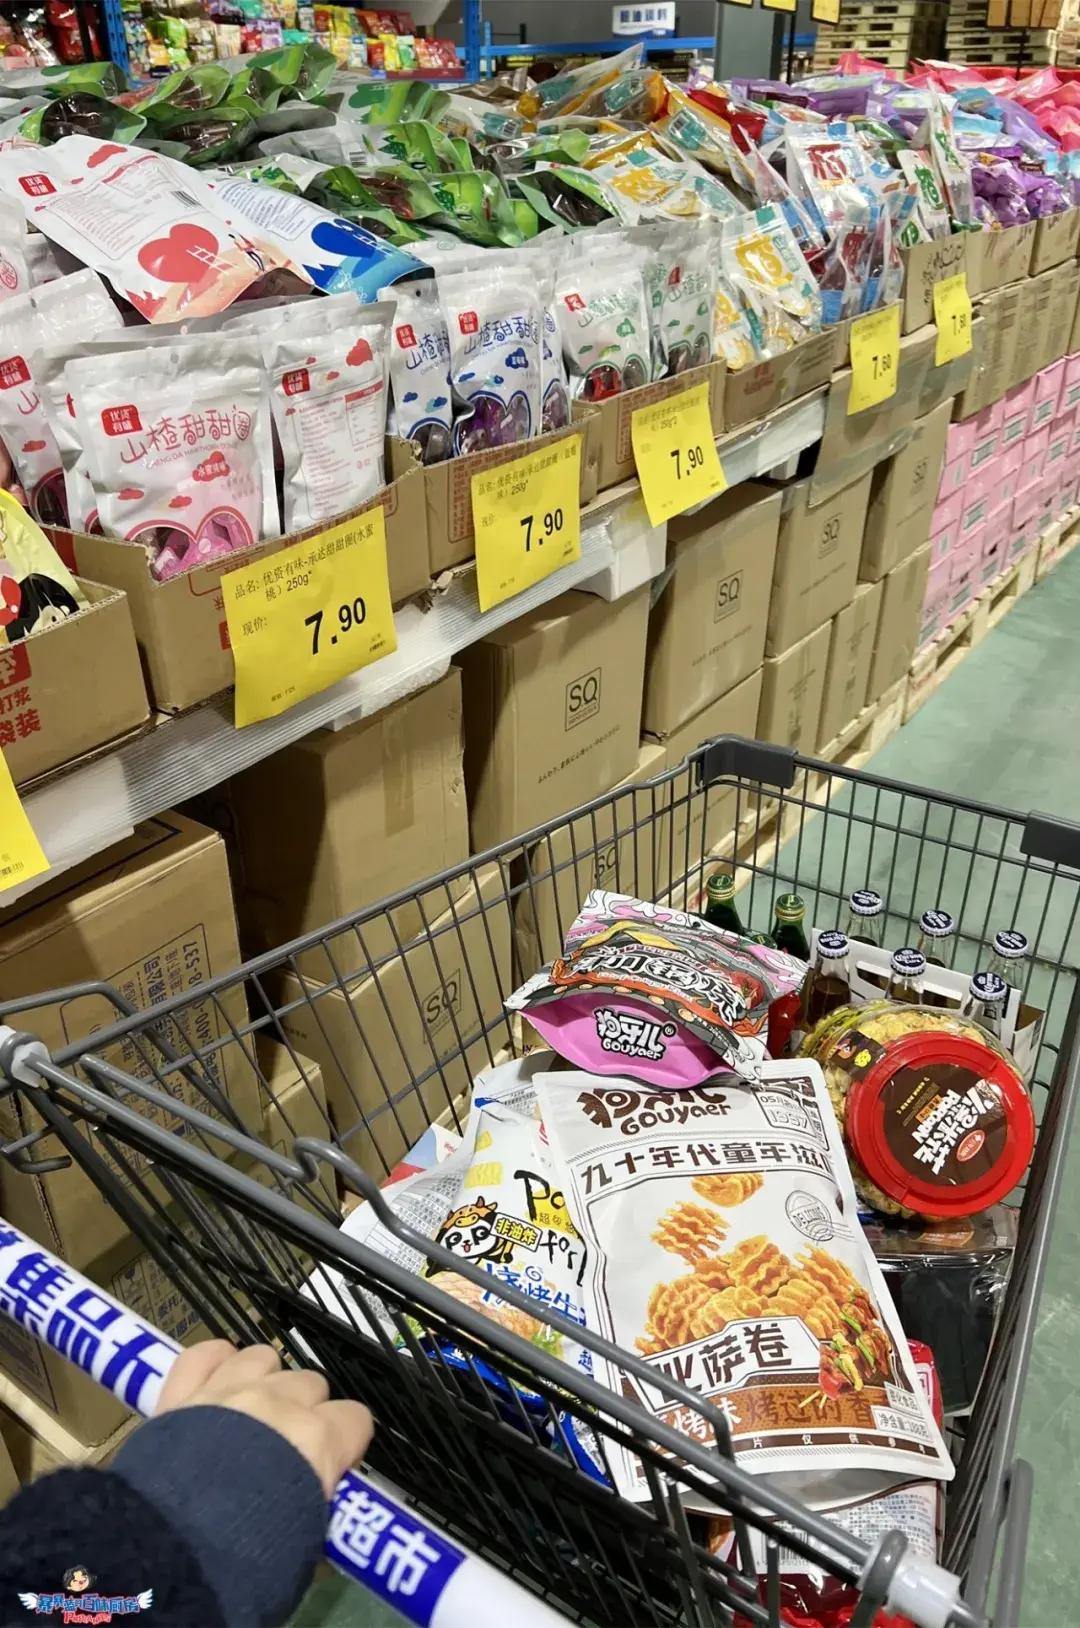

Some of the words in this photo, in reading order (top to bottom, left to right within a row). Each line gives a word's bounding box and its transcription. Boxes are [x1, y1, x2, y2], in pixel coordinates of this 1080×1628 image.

[670, 446, 704, 480] 7.90
[520, 508, 564, 553] 7.90
[718, 577, 741, 607] SQ
[304, 596, 367, 656] 7.90
[569, 676, 598, 713] SQ
[594, 1008, 665, 1052] 狗牙儿
[495, 1217, 538, 1246] 非油炸
[328, 1490, 441, 1597] 超市
